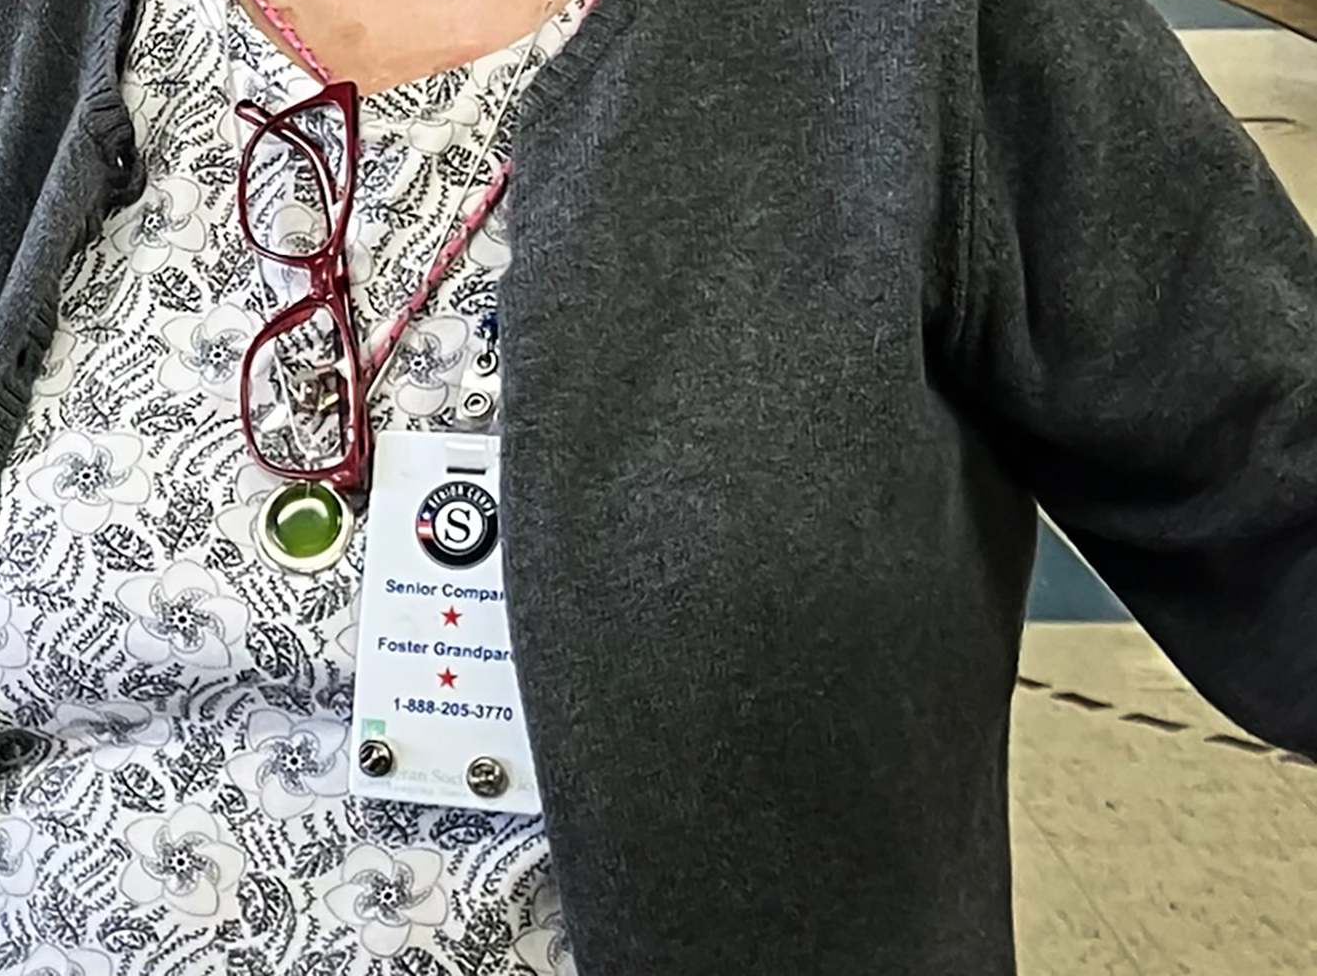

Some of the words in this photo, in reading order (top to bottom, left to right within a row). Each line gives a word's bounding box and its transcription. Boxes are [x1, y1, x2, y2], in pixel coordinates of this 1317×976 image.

[444, 508, 471, 543] S
[385, 579, 437, 596] Senior
[442, 583, 504, 603] Compa
[378, 636, 429, 655] Foster
[434, 641, 511, 663] Grandpar
[394, 697, 514, 721] 1-888-205-3770
